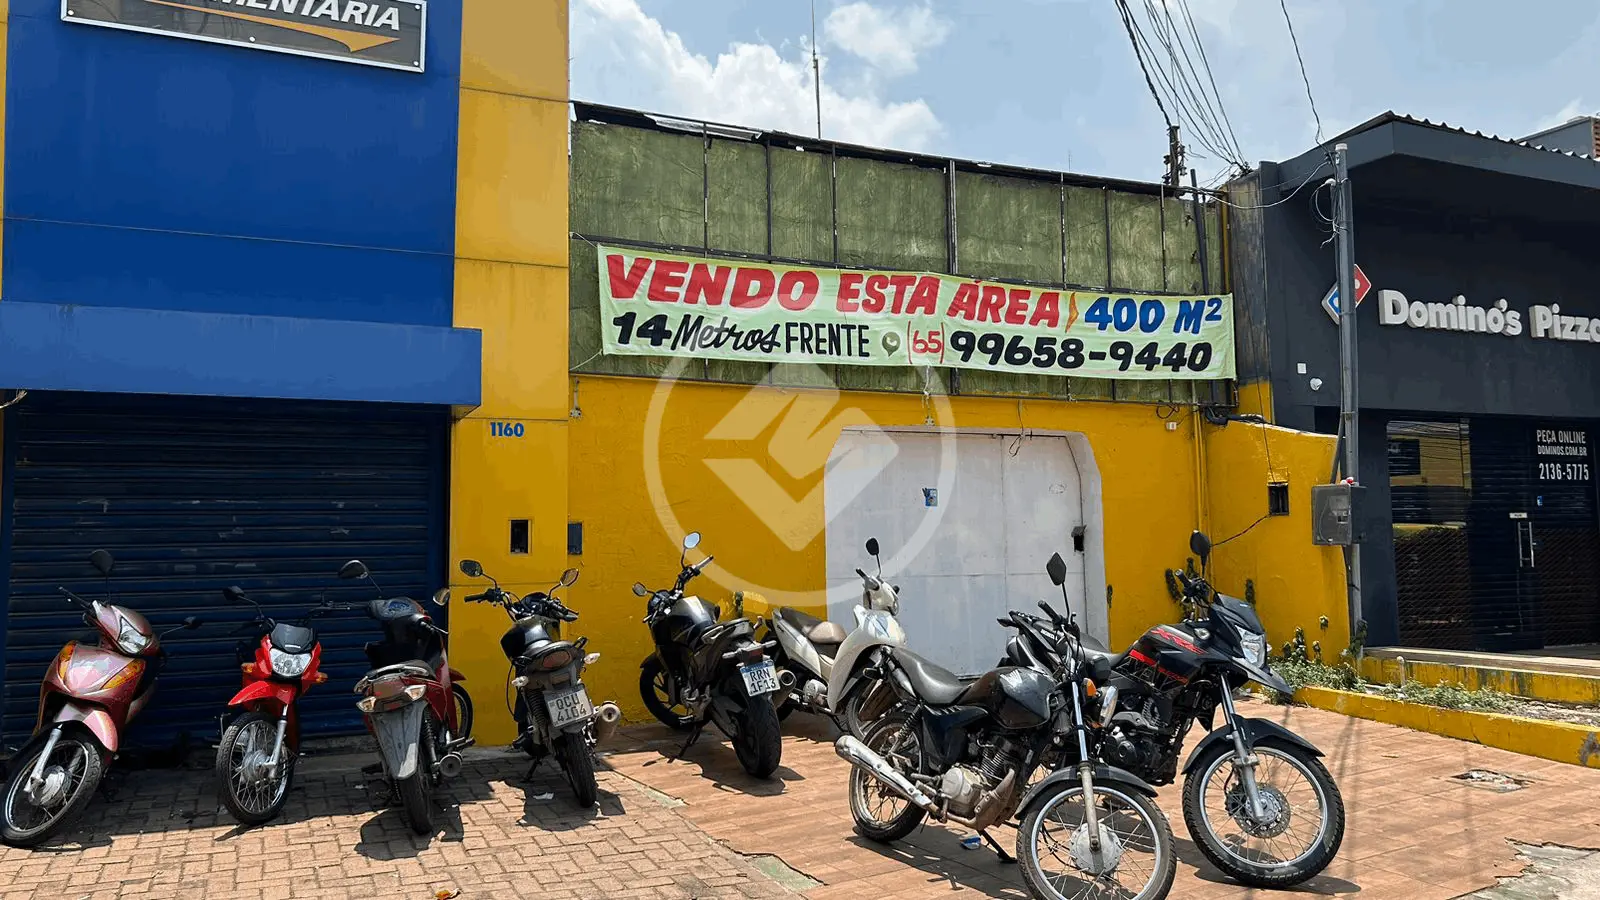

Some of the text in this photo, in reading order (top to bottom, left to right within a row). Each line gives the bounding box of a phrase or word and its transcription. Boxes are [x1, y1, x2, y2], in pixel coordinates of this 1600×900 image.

[606, 254, 820, 311] VENDO
[836, 273, 941, 315] ESTA
[946, 279, 1060, 328] ÁREA
[1084, 297, 1166, 331] 400
[1378, 289, 1523, 336] Domino's
[612, 311, 1212, 372] 14 Metros FRENTE (65) 99658-9440
[490, 421, 525, 438] 1160
[1536, 429, 1587, 444] PEÇA ONLINE
[1537, 445, 1588, 457] DOMINOS.COM.BR
[1538, 462, 1590, 481] 2136-5775
[749, 667, 772, 682] RRN
[750, 677, 777, 693] 1F13
